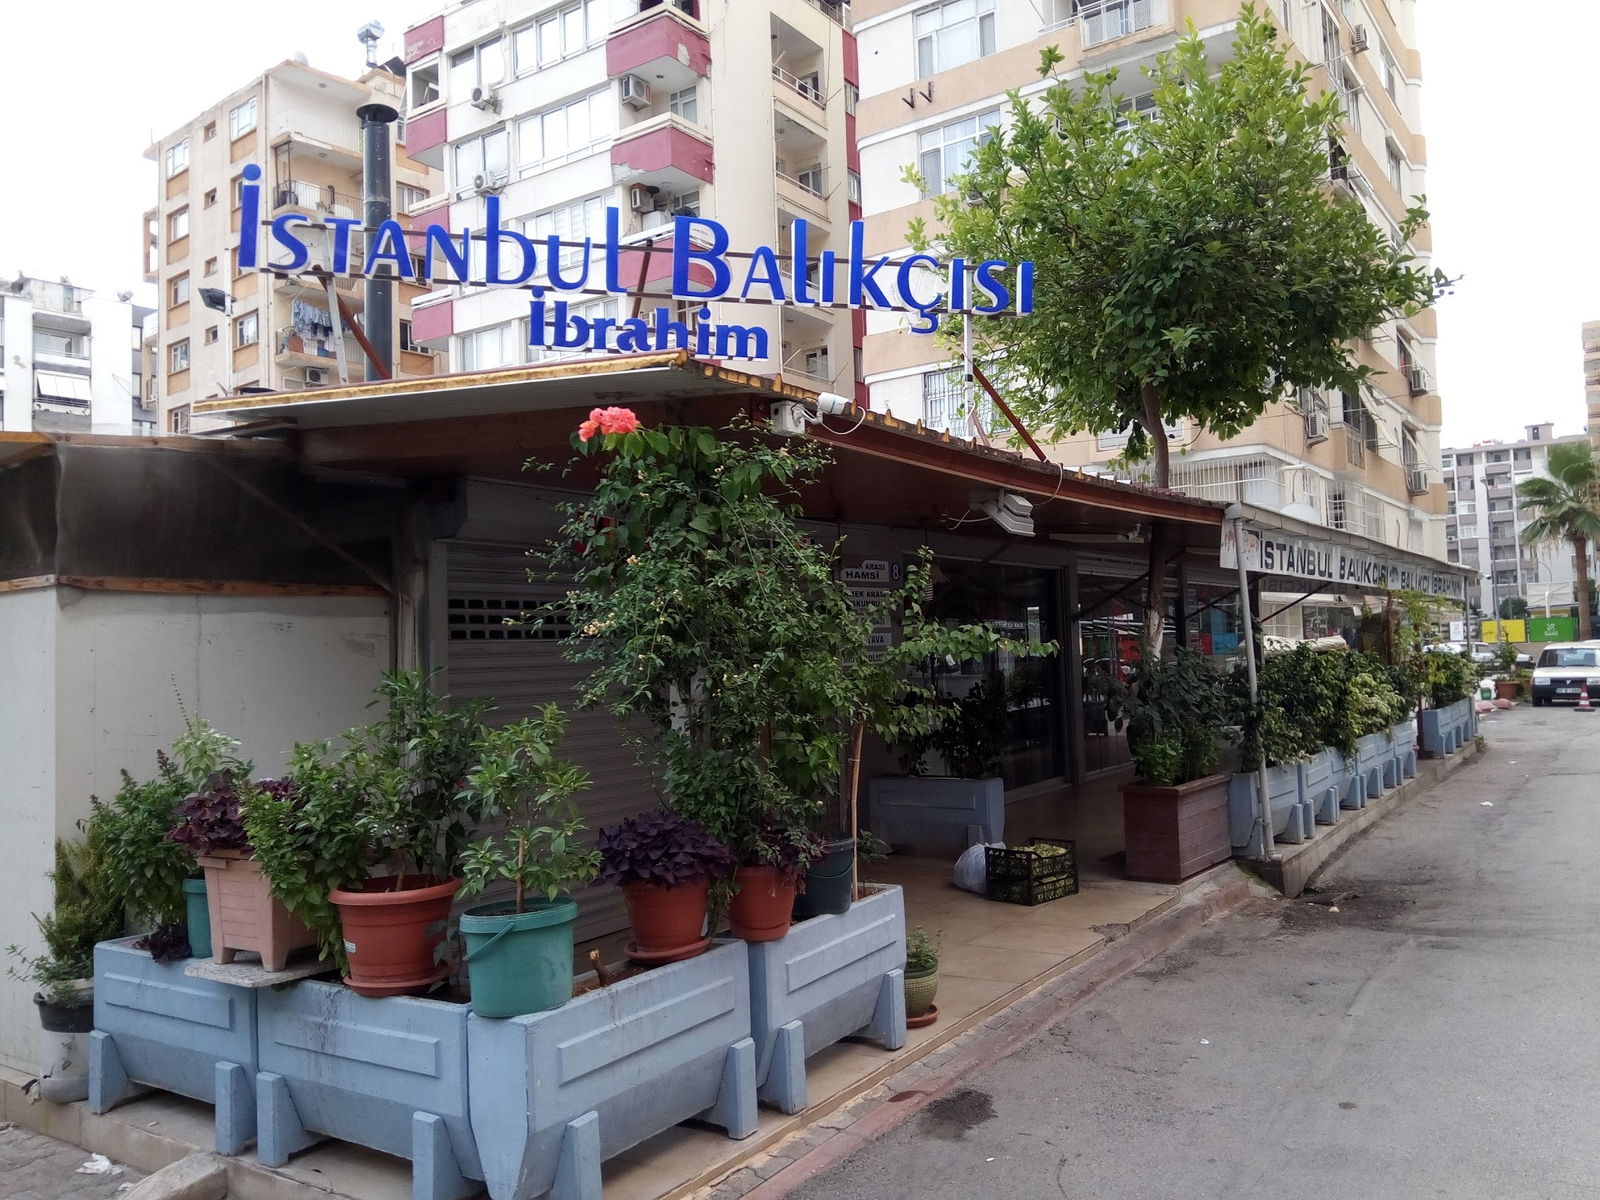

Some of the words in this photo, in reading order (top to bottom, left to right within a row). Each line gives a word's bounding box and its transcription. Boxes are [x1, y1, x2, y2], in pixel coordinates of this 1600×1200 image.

[1260, 531, 1333, 579] İSTANBUL
[846, 571, 879, 580] HAMSİ
[892, 563, 900, 581] 8
